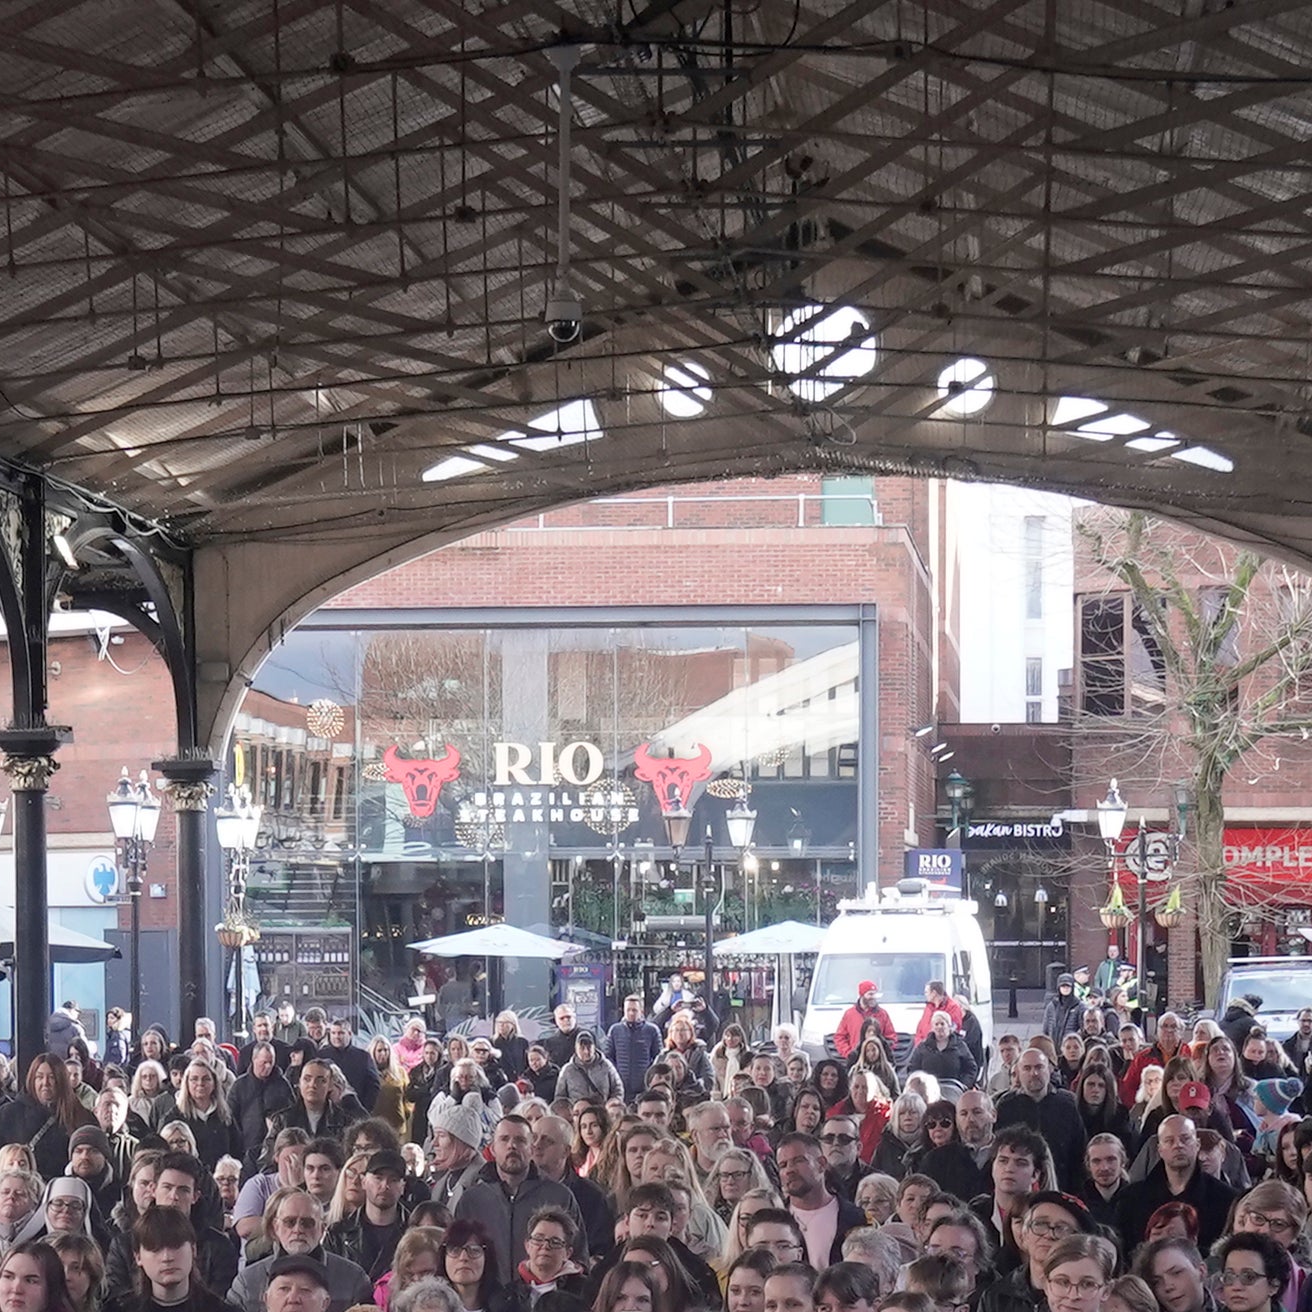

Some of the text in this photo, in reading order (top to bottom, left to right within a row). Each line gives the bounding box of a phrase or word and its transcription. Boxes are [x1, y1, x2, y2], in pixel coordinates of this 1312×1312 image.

[493, 741, 605, 786] RIO
[474, 792, 626, 806] BRAZILIAN
[459, 808, 640, 823] STEAKHOUSE
[918, 854, 952, 868] RIO
